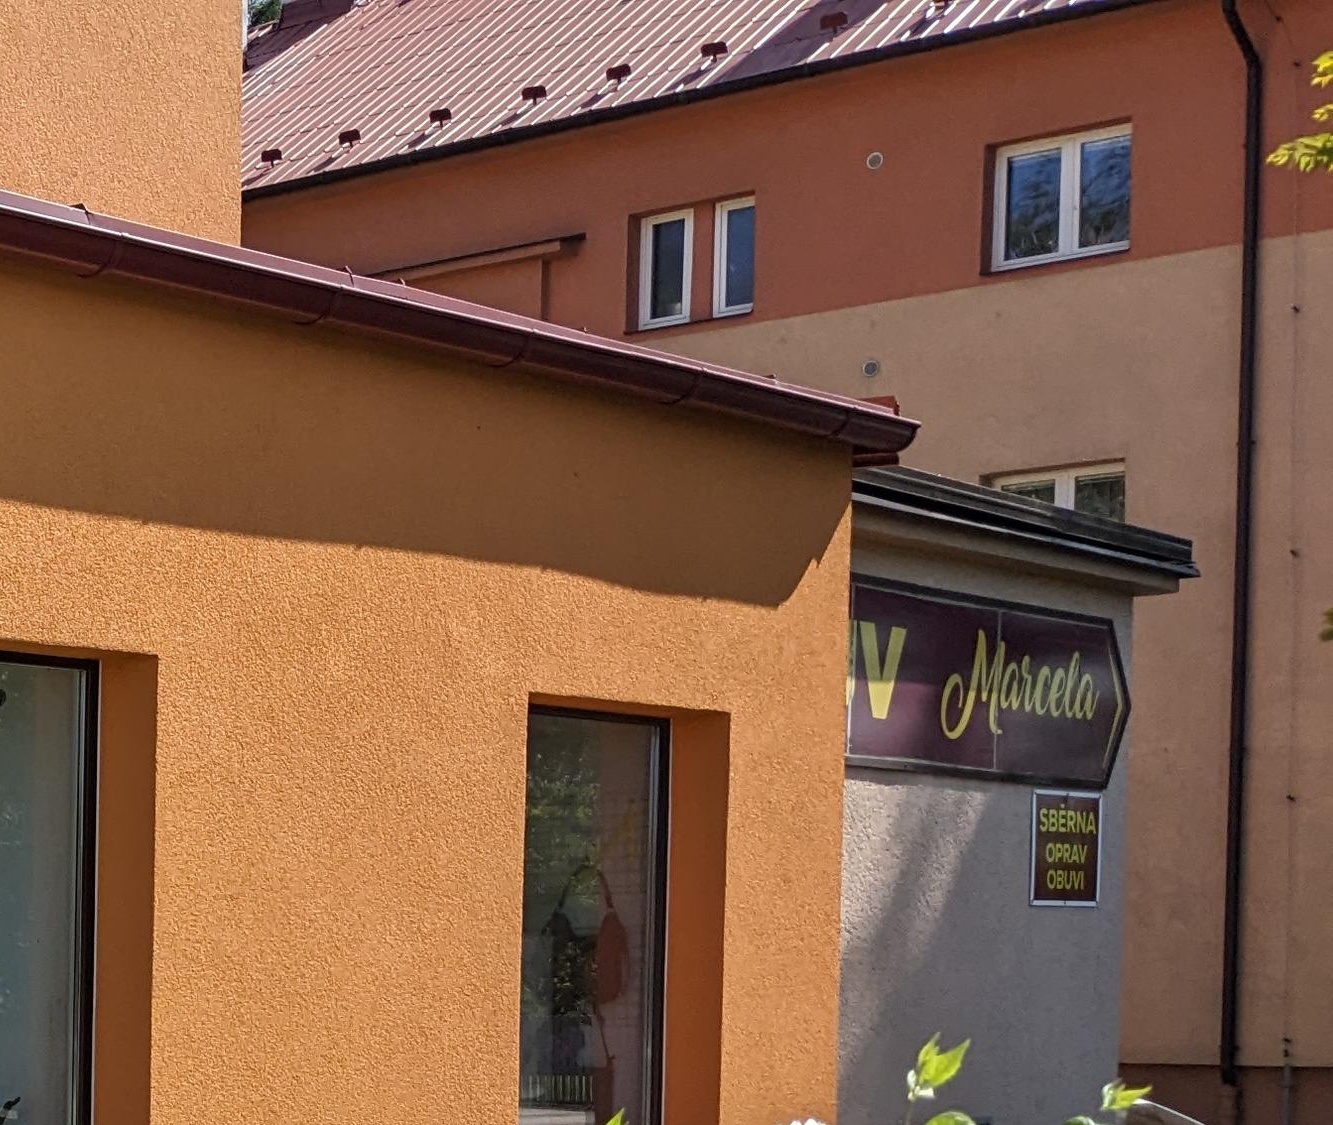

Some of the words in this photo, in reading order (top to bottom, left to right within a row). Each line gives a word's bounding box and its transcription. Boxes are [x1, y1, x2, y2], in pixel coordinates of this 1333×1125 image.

[846, 620, 907, 719] V
[941, 628, 1100, 740] Marcela
[1046, 843, 1088, 864] OPRAV
[1047, 869, 1085, 890] OBUVI
